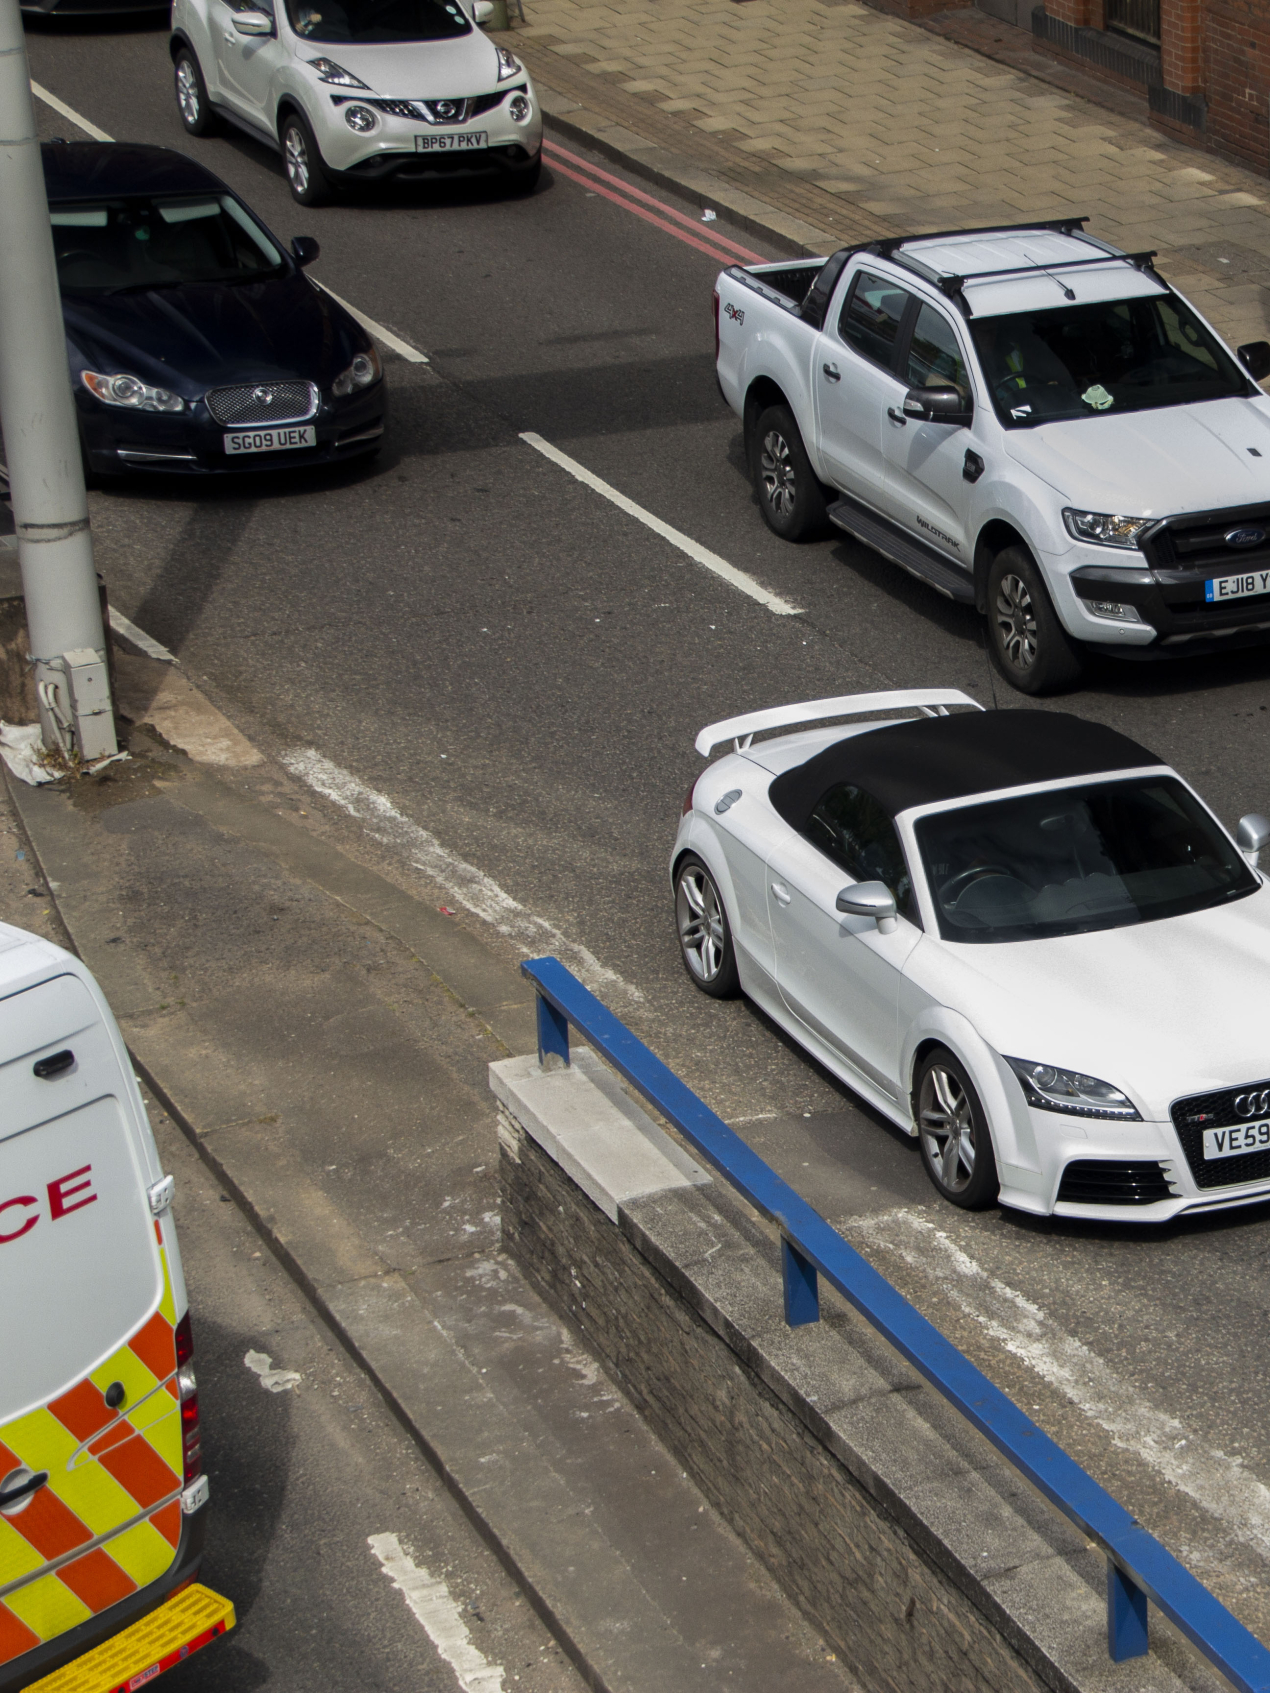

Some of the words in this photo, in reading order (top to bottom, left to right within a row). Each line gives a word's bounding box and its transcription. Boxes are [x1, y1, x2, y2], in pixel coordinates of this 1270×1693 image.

[422, 136, 454, 149] BP67
[458, 134, 481, 147] PKV
[231, 432, 273, 450] SG09
[277, 429, 308, 446] UEK
[916, 515, 960, 552] WILDTRAK
[1219, 576, 1255, 596] EJ18
[1214, 1123, 1270, 1152] VE59
